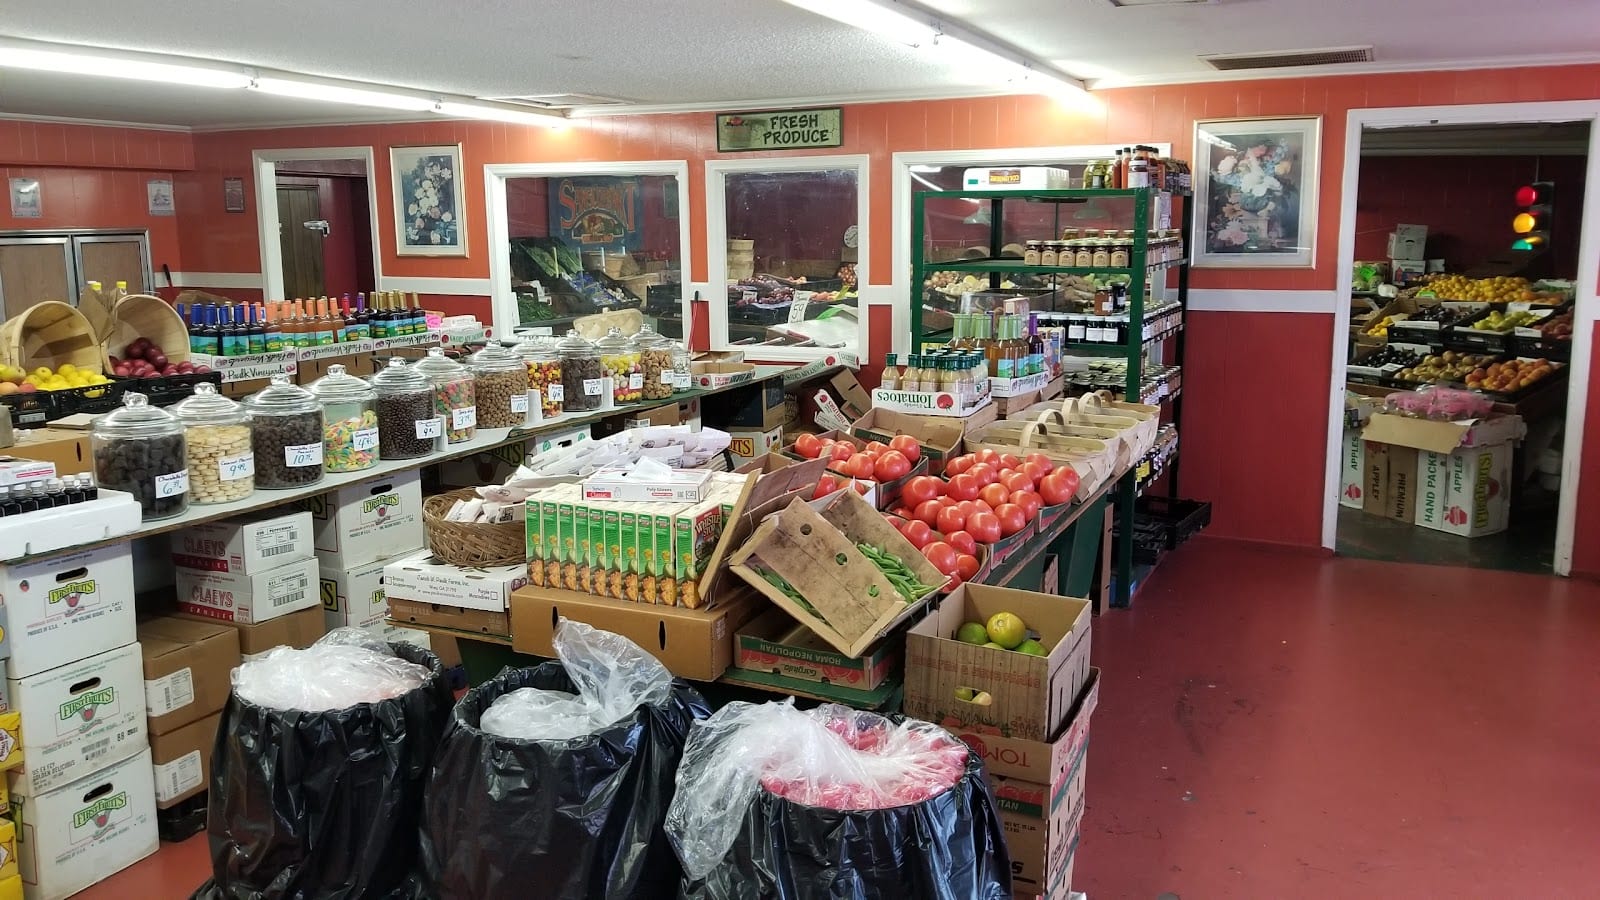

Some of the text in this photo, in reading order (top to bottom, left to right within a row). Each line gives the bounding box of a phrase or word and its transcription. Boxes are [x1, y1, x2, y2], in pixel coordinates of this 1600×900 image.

[770, 114, 819, 129] FRESH
[763, 129, 829, 145] PRODUCE
[227, 365, 286, 380] Paulk Vineyards
[877, 391, 936, 409] Tomatoes
[1351, 436, 1359, 470] APPLES
[1454, 456, 1463, 493] APPLES
[1396, 473, 1406, 518] PREMIUM
[1424, 451, 1437, 522] HAND PACKE
[695, 514, 721, 534] WHISTLE
[184, 536, 226, 557] CLAEYS
[192, 585, 234, 608] CLAEYS
[189, 606, 233, 620] CANDIES
[760, 643, 841, 665] ROMA NEOPOLITAN
[62, 689, 112, 719] FIRSTFRUITS
[33, 760, 76, 782] GOLDEN DELICIOUS
[77, 796, 124, 825] FIRSTFRUITS
